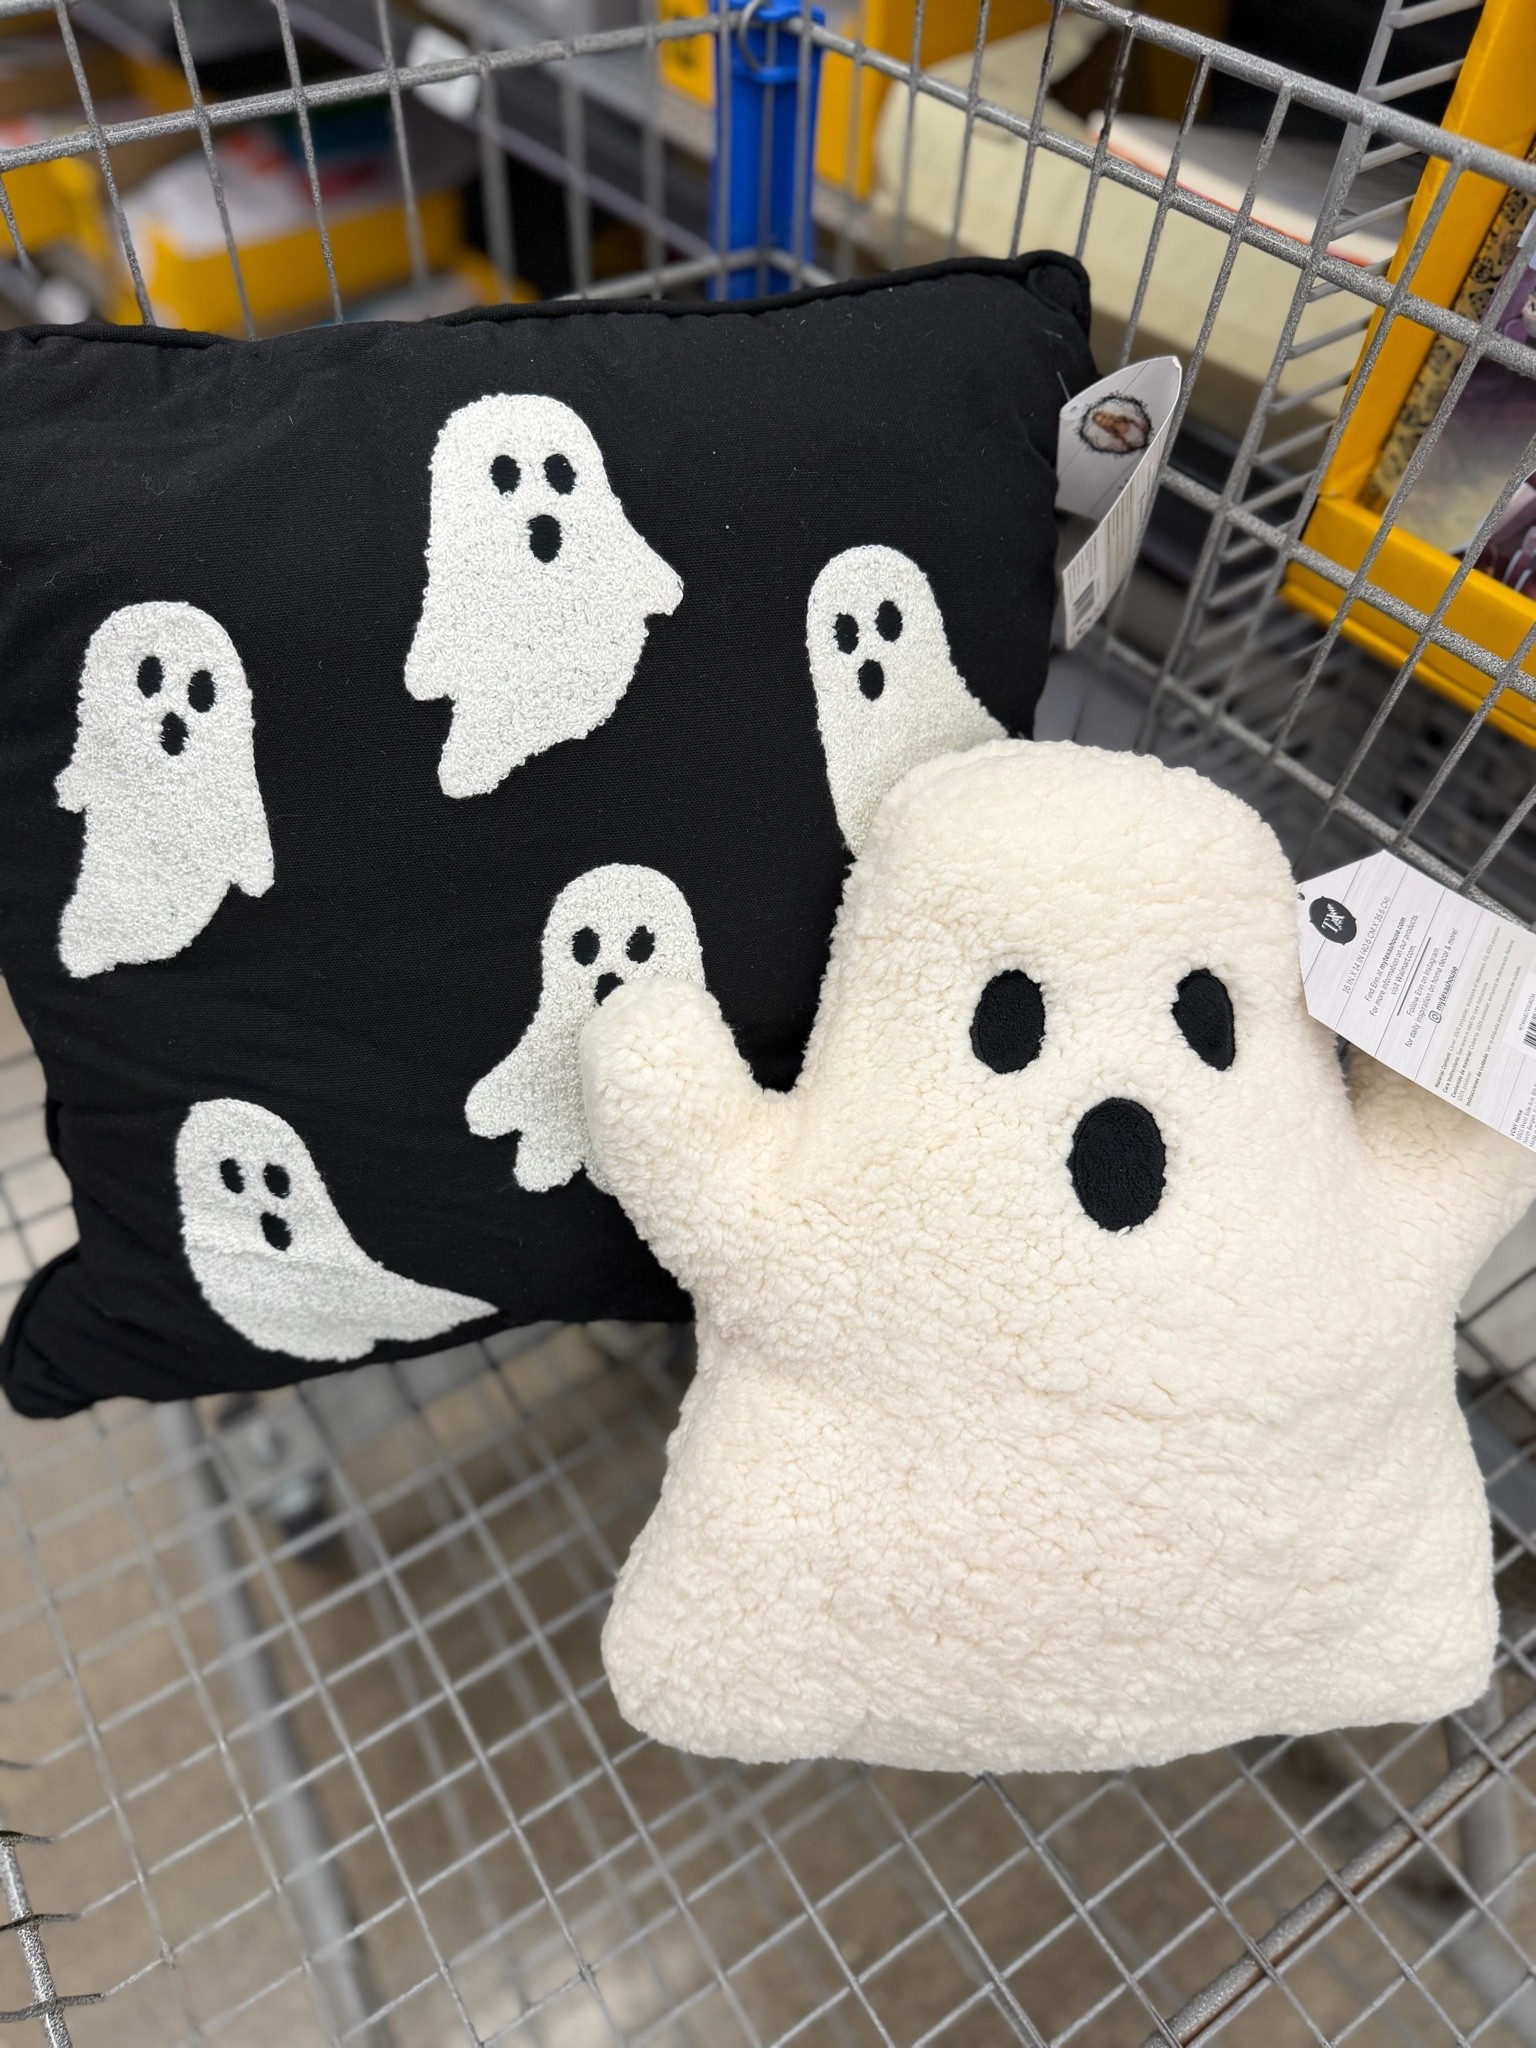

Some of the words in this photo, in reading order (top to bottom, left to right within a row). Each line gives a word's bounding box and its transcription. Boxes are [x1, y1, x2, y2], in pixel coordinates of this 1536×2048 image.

[1380, 894, 1390, 909] CM)
[1374, 907, 1384, 922] 35.6
[1371, 920, 1379, 928] X
[1366, 926, 1376, 939] CM
[1446, 927, 1458, 946] more!
[1378, 915, 1407, 971] mytexashouse.com
[1398, 938, 1407, 949] our
[1356, 953, 1364, 963] IN
[1395, 948, 1403, 958] on
[1437, 949, 1449, 968] decor
[1352, 962, 1360, 971] 14
[1423, 946, 1440, 976] Instagram
[1349, 969, 1357, 977] X
[1375, 968, 1383, 977] at
[1380, 956, 1399, 990] information
[1420, 975, 1427, 984] on
[1431, 966, 1442, 984] home
[1346, 976, 1354, 986] IN
[1370, 975, 1380, 988] Erin
[1428, 984, 1435, 992] on
[1434, 964, 1459, 1011] mytexashouse
[1342, 984, 1351, 994] 16
[1364, 986, 1375, 1002] Find
[1390, 982, 1400, 996] visit
[1414, 982, 1424, 996] Erin
[1374, 989, 1385, 1006] more
[1369, 1004, 1378, 1016] For
[1405, 994, 1419, 1016] Follow
[1415, 992, 1433, 1024] inspiration
[1408, 1021, 1420, 1039] daily
[1405, 1037, 1413, 1048] for
